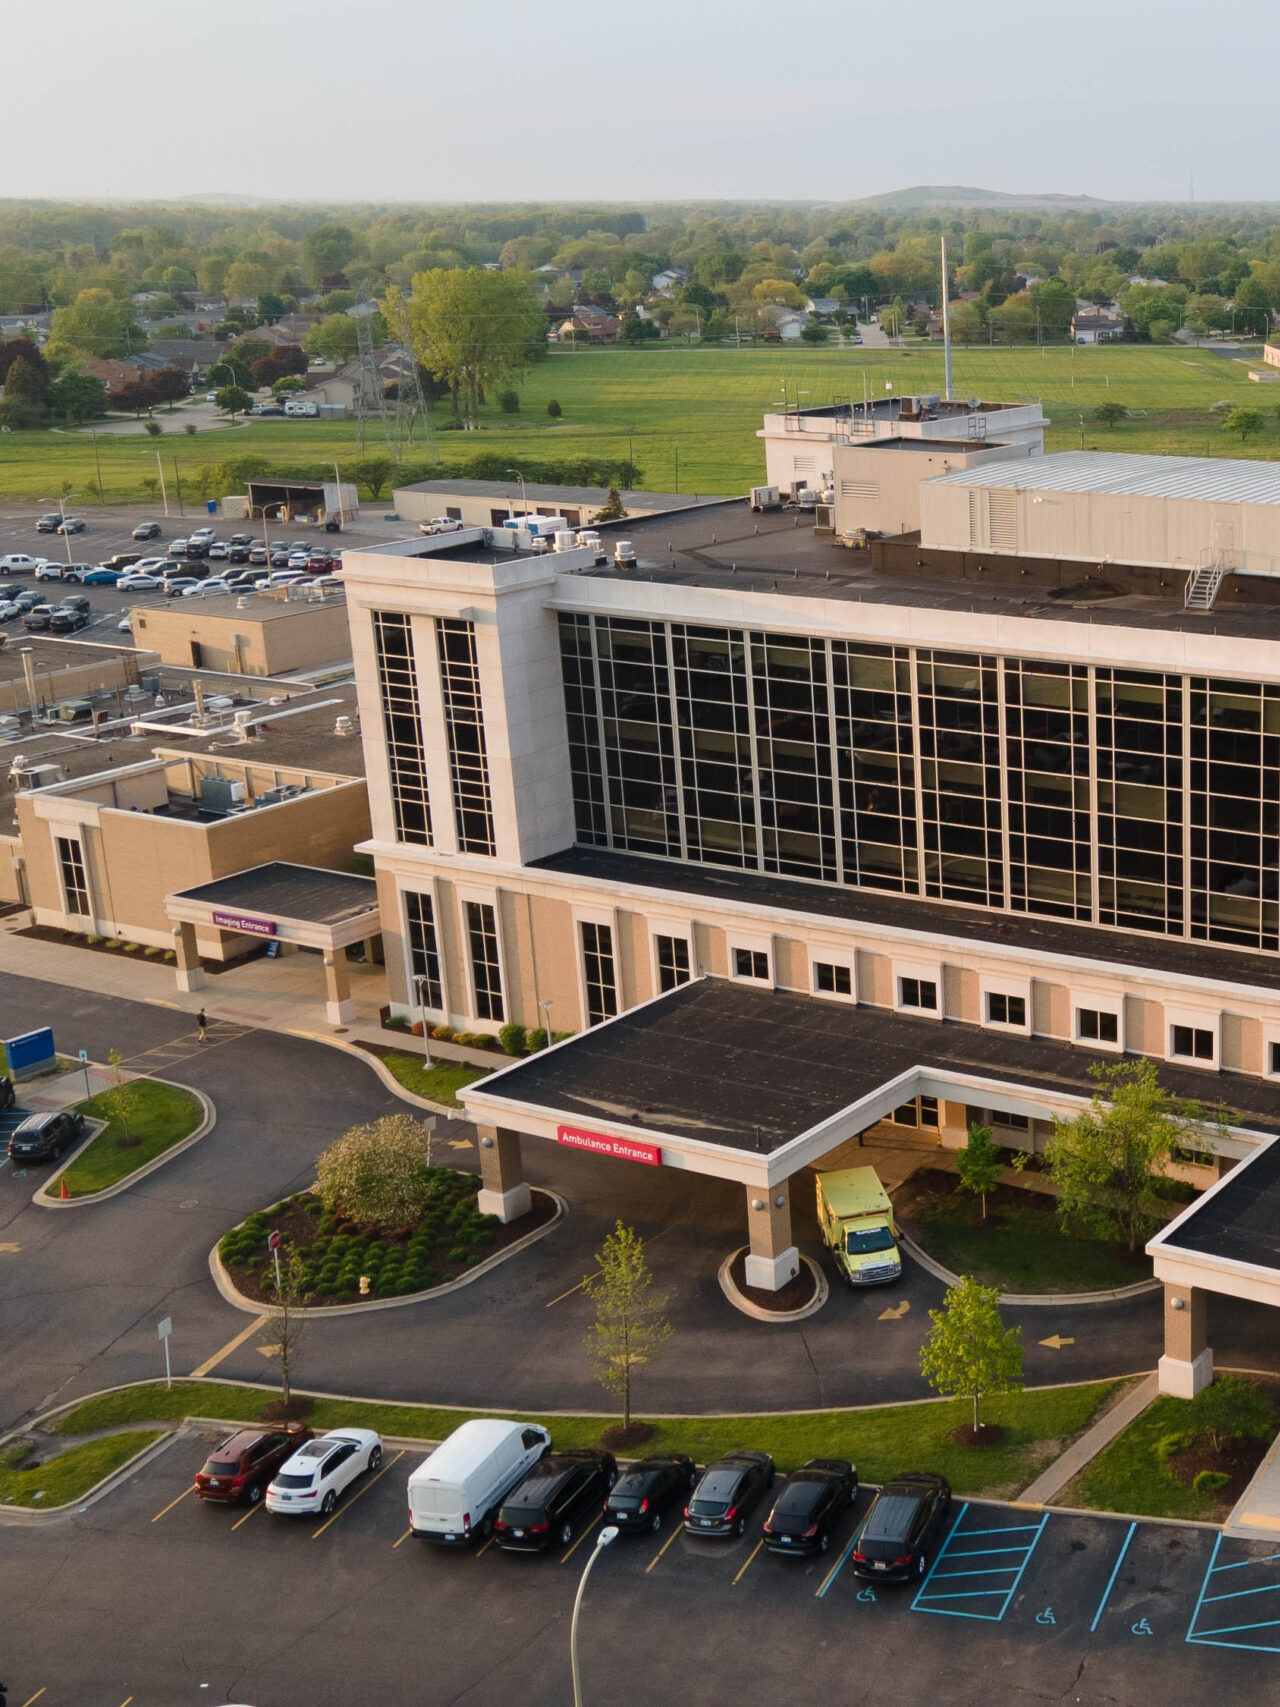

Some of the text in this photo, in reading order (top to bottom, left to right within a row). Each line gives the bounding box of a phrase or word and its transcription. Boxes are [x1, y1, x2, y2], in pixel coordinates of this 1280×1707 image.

[215, 915, 270, 933] Imaging Entrance
[562, 1132, 653, 1161] Ambulance Entrance
